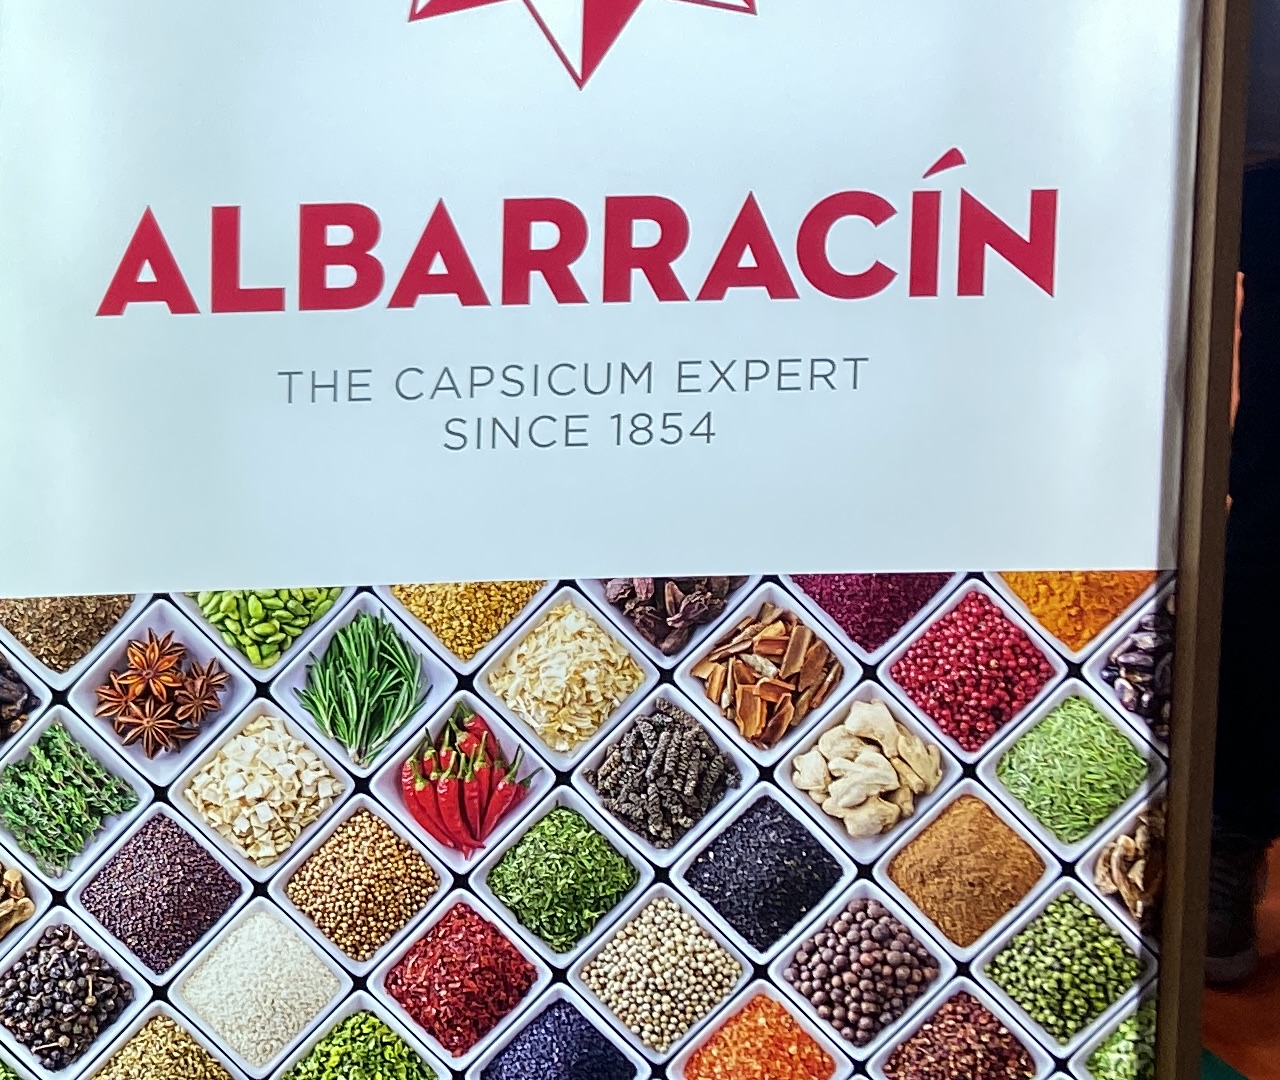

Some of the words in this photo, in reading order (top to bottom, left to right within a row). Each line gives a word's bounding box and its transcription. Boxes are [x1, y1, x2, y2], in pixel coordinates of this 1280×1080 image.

[97, 148, 1059, 317] ALBARRACÍN
[276, 368, 373, 405] THE
[394, 361, 656, 402] CAPSICUM
[677, 357, 870, 394] EXPERT
[443, 414, 590, 451] SINCE
[610, 411, 717, 446] 1854
